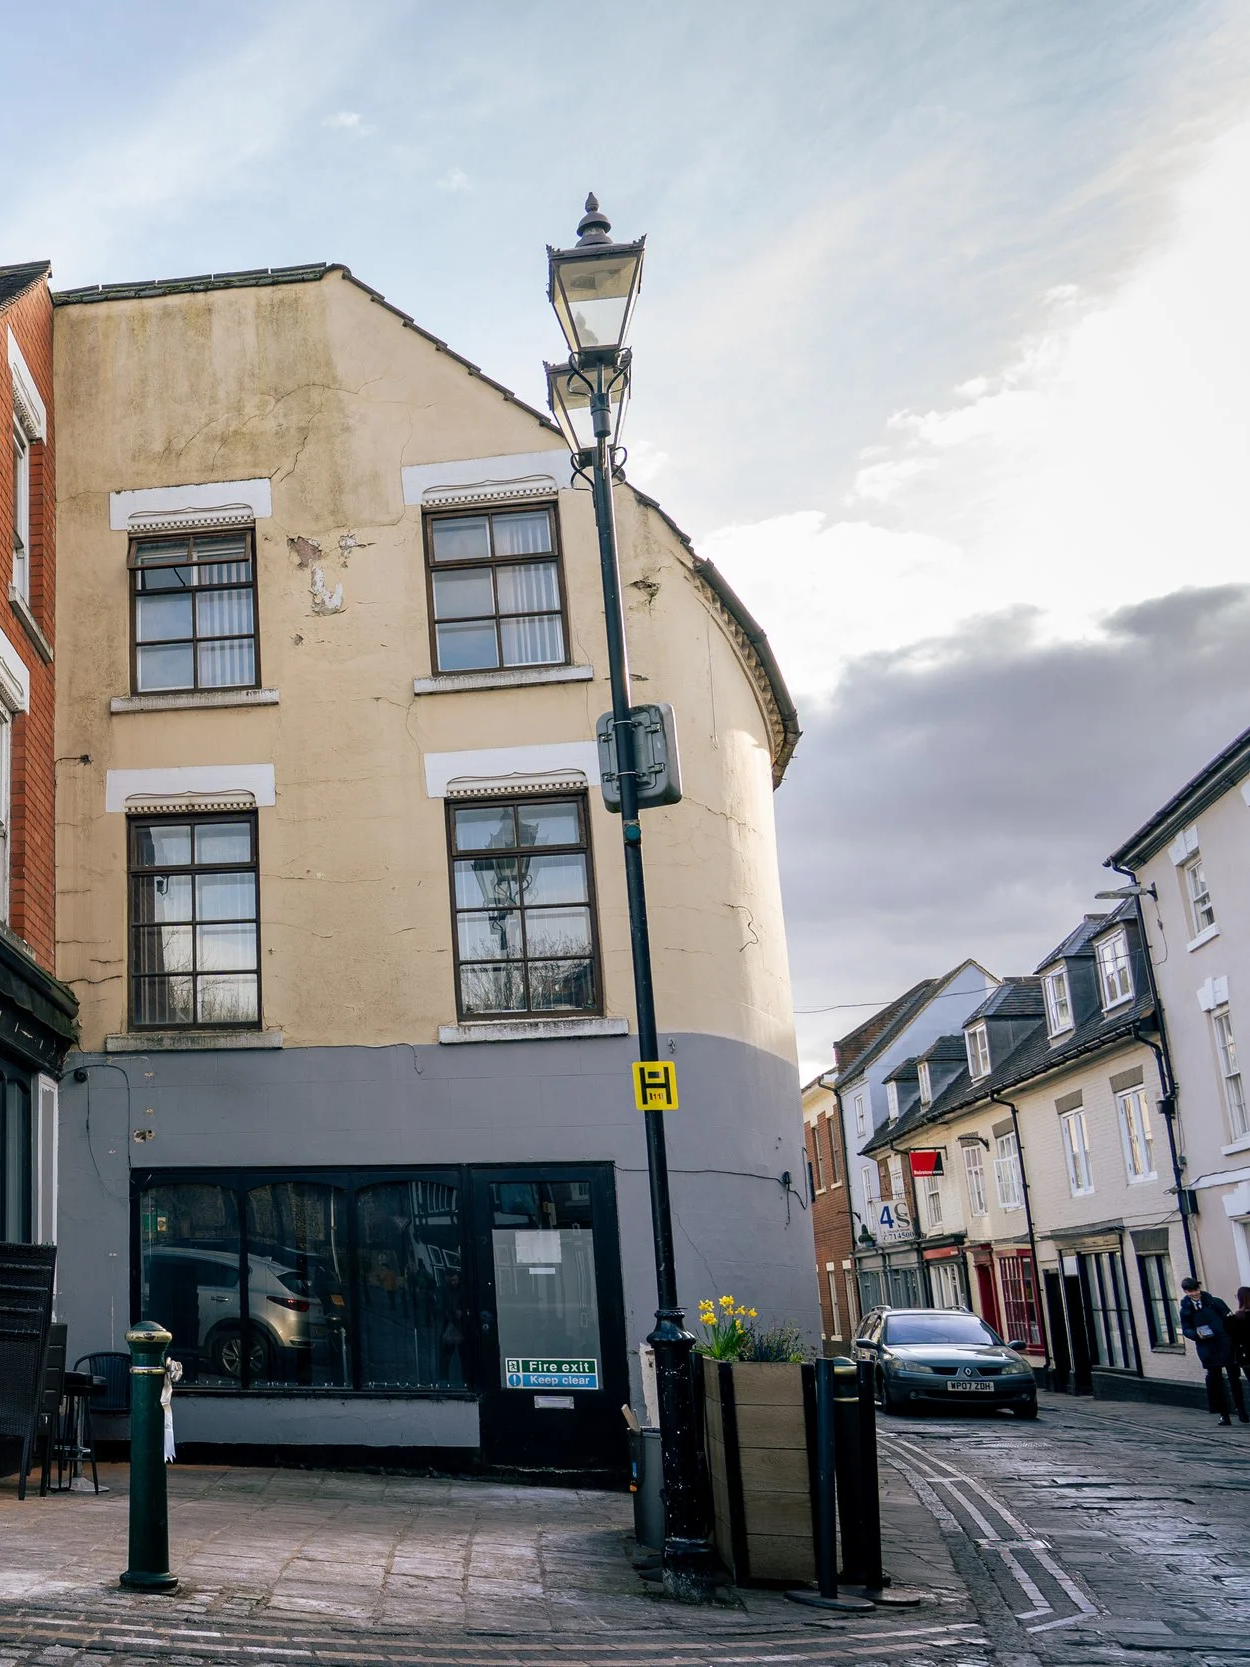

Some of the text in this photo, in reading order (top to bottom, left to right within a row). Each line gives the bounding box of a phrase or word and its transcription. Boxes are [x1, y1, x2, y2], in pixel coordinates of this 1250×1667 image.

[529, 1361, 590, 1372] Fire exit
[529, 1375, 590, 1386] Keep clear
